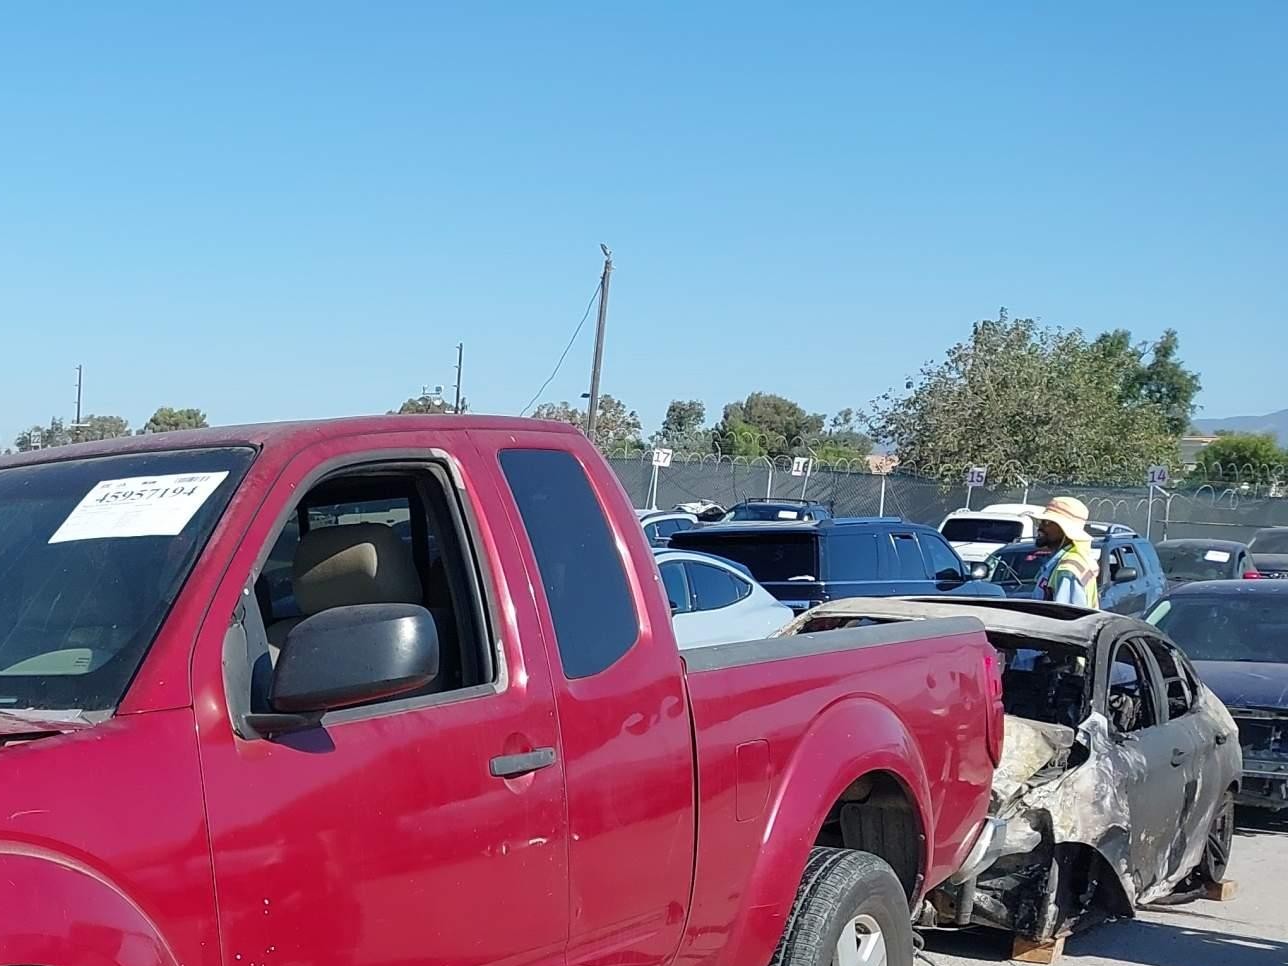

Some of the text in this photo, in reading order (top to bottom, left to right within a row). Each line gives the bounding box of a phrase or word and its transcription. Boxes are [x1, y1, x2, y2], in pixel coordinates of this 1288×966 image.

[653, 451, 671, 464] 17
[968, 470, 985, 483] 15
[1149, 468, 1166, 483] 14
[96, 485, 199, 504] 45957194
